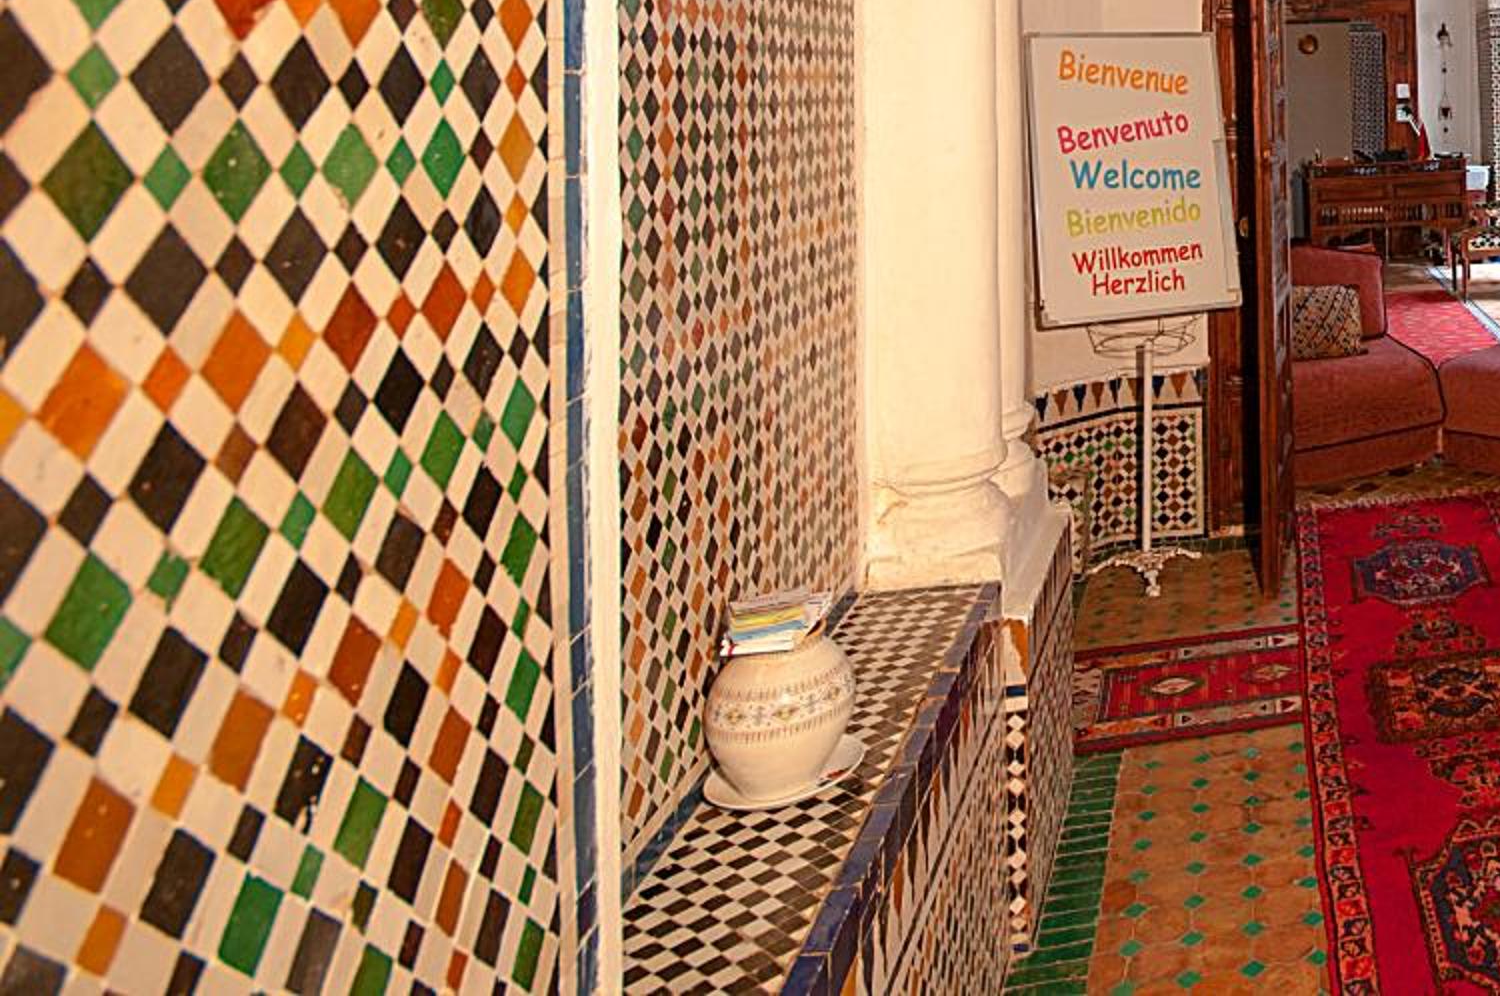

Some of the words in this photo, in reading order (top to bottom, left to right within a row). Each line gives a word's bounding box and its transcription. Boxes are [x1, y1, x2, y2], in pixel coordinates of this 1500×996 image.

[1058, 50, 1188, 95] Bienvenue
[1057, 110, 1189, 154] Benvenuto
[1070, 160, 1201, 190] Welcome
[1066, 197, 1201, 237] Bienvenido
[1072, 242, 1203, 273] Willkommen
[1091, 269, 1185, 296] Herzlich
